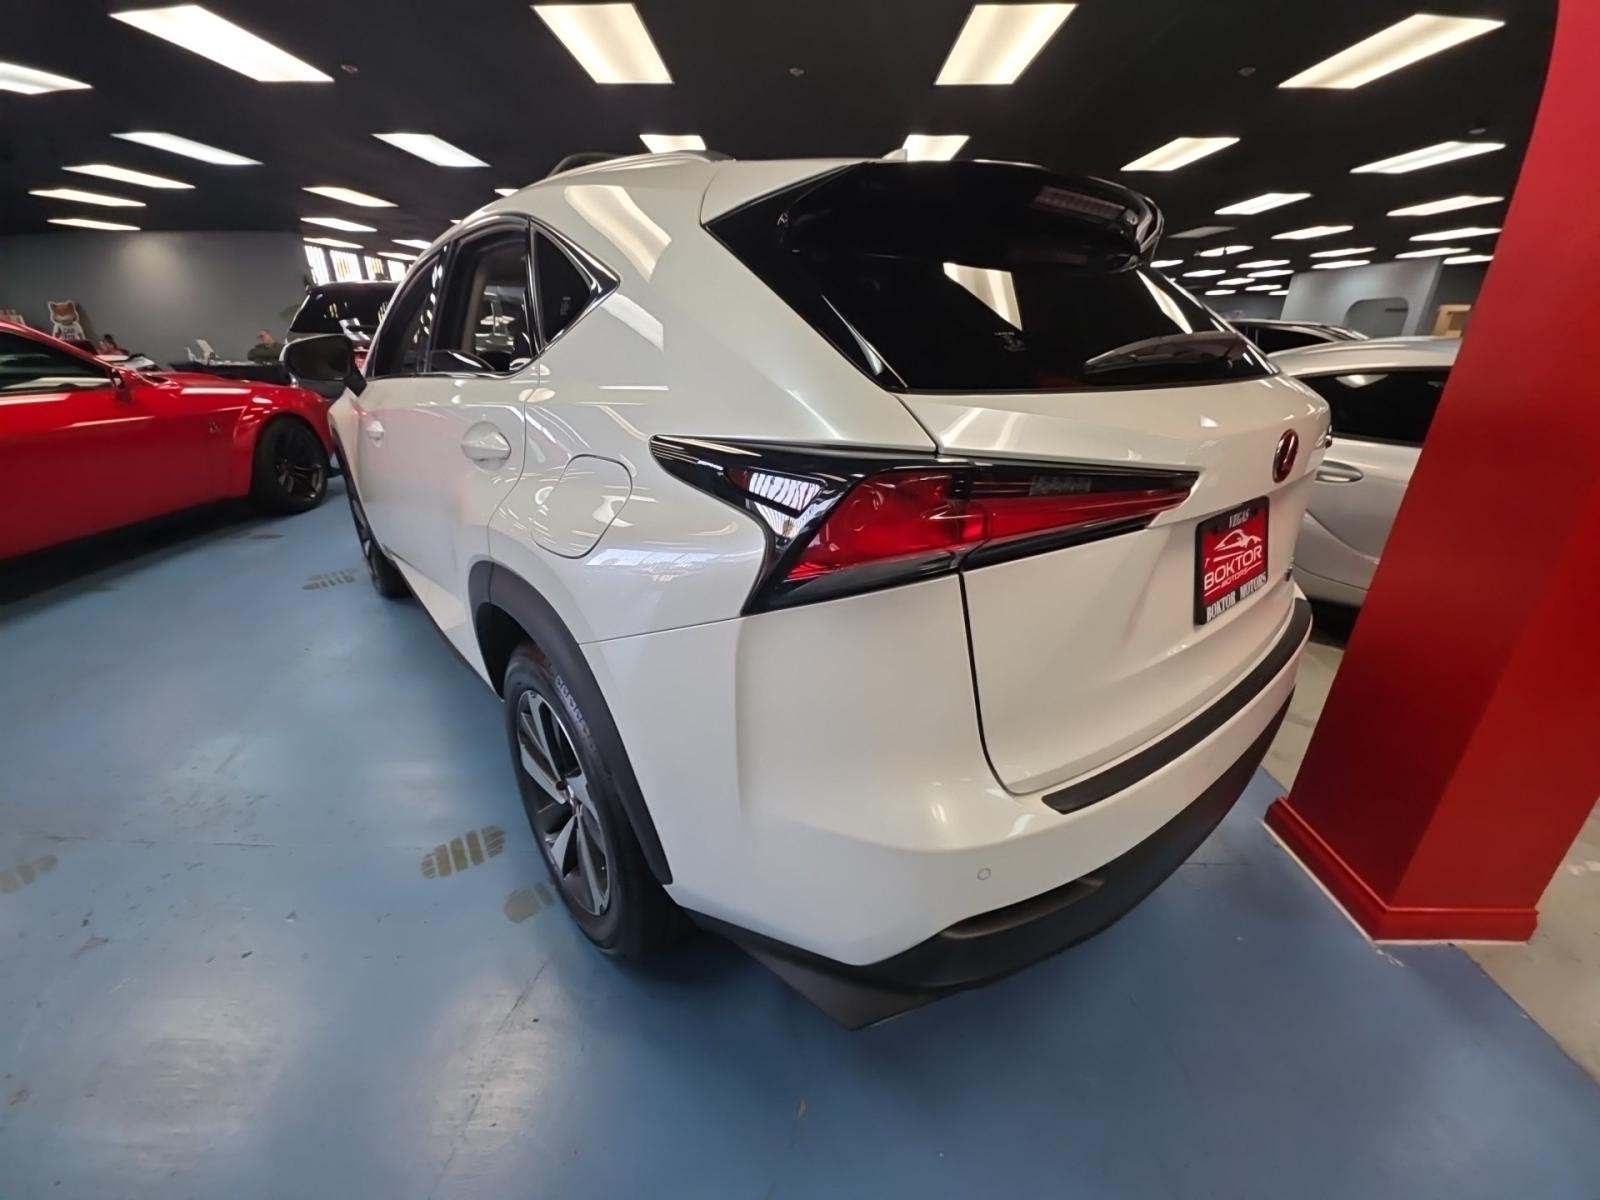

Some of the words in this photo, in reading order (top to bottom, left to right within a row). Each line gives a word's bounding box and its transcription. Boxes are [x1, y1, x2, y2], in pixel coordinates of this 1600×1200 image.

[1204, 545, 1262, 591] BOKTOR
[1221, 567, 1248, 588] MOTORS
[1206, 590, 1236, 621] BOKTOR
[1240, 572, 1267, 600] MOTORS
